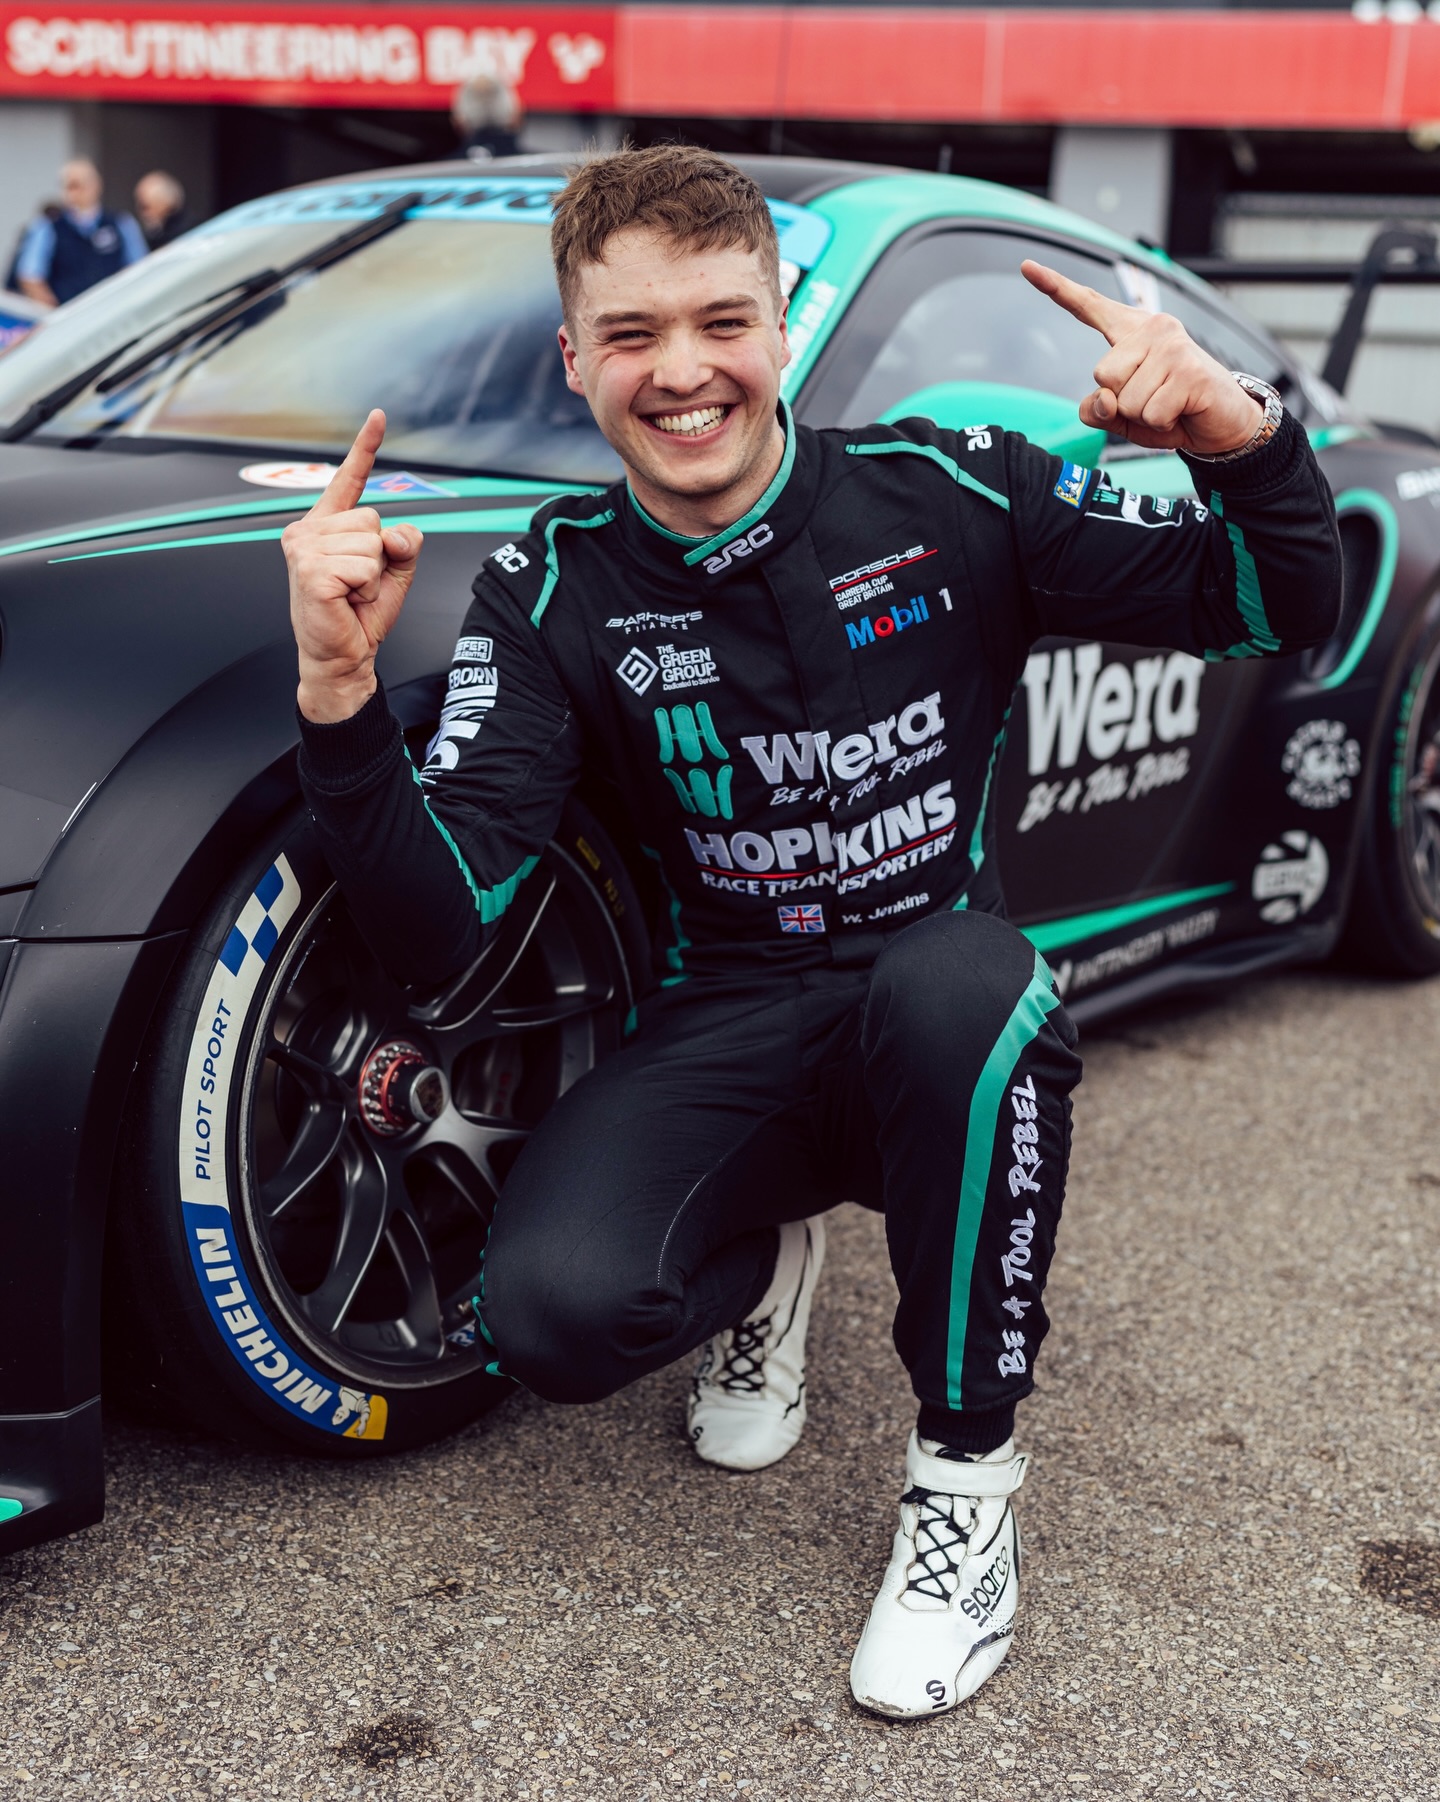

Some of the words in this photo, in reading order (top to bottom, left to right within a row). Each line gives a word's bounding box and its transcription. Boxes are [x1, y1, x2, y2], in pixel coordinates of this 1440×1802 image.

[6, 16, 419, 83] SCRUTINEERING
[424, 26, 537, 85] BAY
[829, 545, 925, 589] PORSCHE
[835, 581, 872, 602] CARRERA
[872, 575, 888, 588] CUP
[605, 611, 703, 627] BARKER'S
[838, 595, 862, 610] GREAT
[863, 582, 894, 601] BRITAIN
[845, 595, 929, 650] Mobil
[939, 588, 953, 611] 1
[656, 644, 675, 655] THE
[659, 647, 712, 668] GREEN
[662, 662, 716, 683] GROUP
[1022, 643, 1206, 776] Wera
[740, 691, 945, 790] Wera
[770, 787, 805, 805] BE
[888, 739, 947, 782] REBEL
[684, 780, 957, 874] HOPKINS
[701, 871, 760, 895] RACE
[868, 892, 929, 920] Jenkins
[201, 998, 231, 1095] SPORT
[196, 1099, 212, 1180] PILOT
[1008, 1074, 1043, 1197] REBEL
[1001, 1207, 1036, 1287] TOOL
[196, 1228, 332, 1414] MICHELIN
[1002, 1295, 1031, 1320] A
[998, 1328, 1027, 1378] BE
